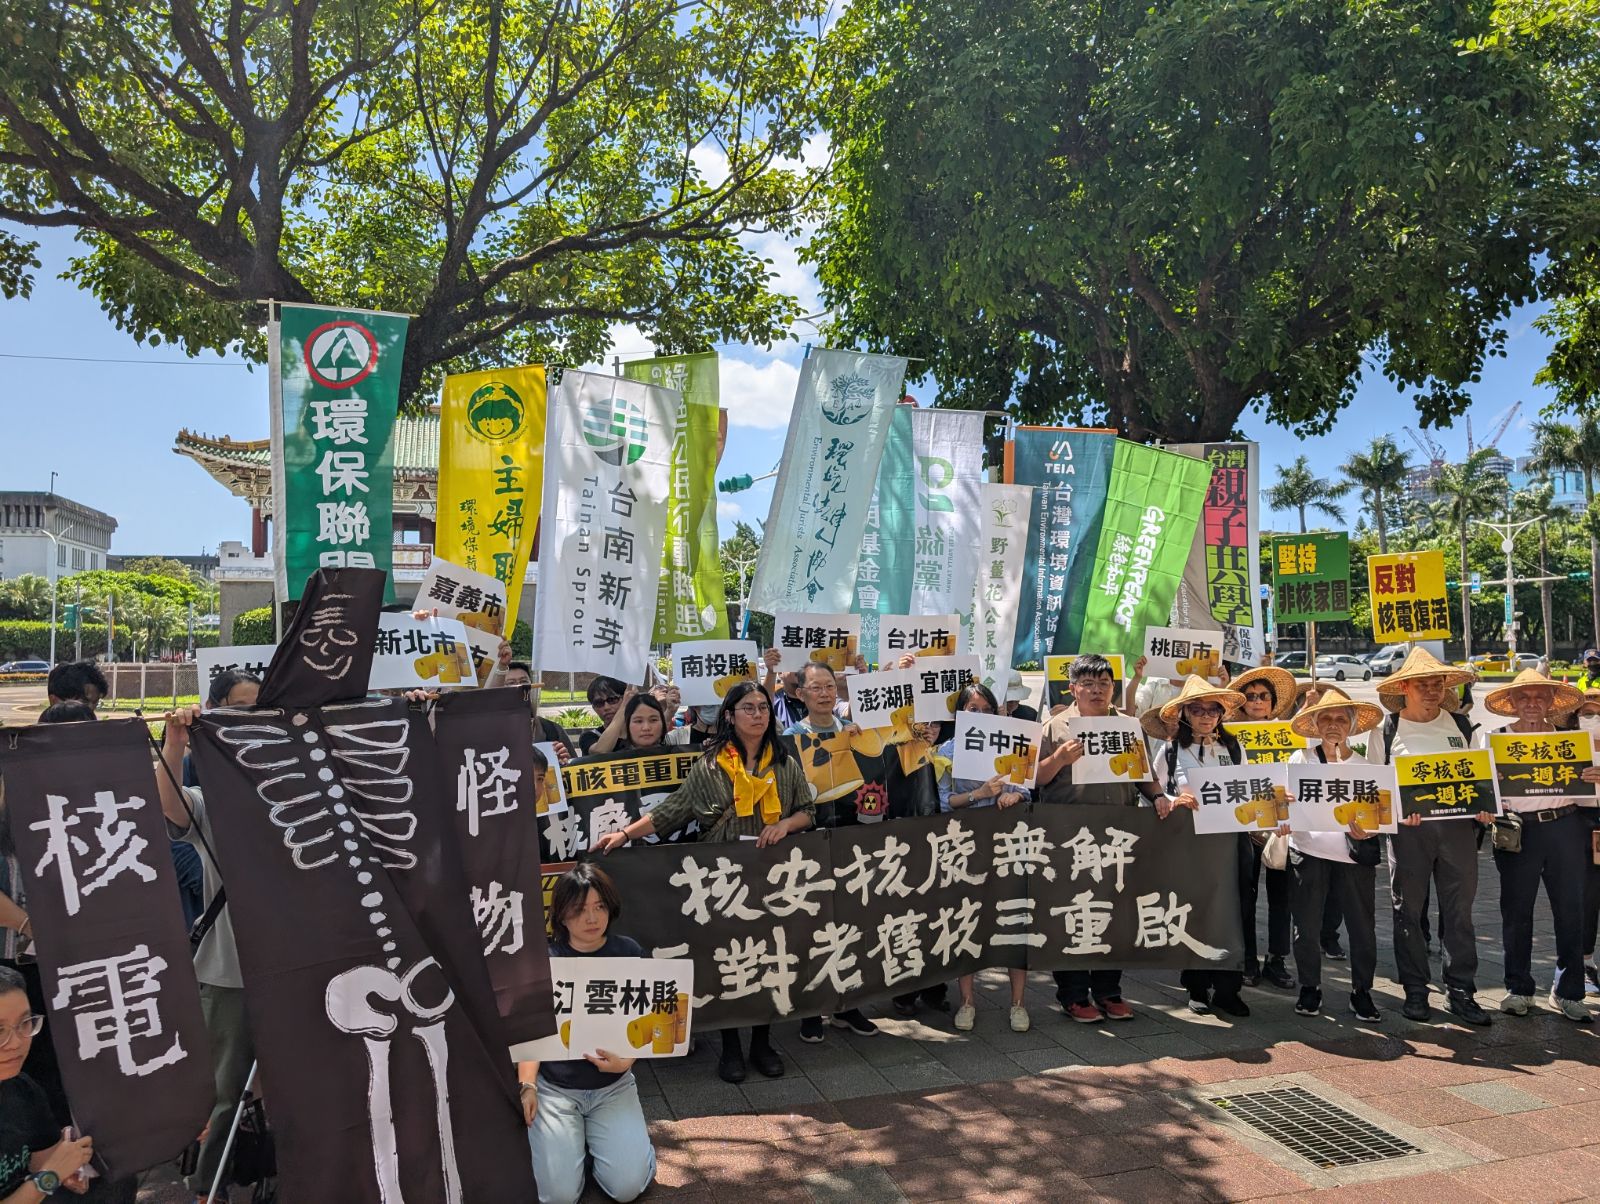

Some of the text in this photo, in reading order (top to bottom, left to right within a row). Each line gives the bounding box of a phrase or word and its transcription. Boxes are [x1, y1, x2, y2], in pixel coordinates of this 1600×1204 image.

[1045, 463, 1075, 475] TEIA
[572, 476, 599, 646] Tainan Sprout
[592, 480, 638, 655] 台南新芽
[1033, 481, 1051, 653] Taiwan Environmental Information Association
[1098, 532, 1132, 596] 綠色和平
[1279, 543, 1316, 574] 堅持
[1374, 563, 1416, 594] 反對
[428, 575, 501, 617] 嘉義市
[1279, 580, 1347, 614] 非核家園
[1378, 597, 1448, 634] 核電復活
[374, 628, 456, 655] 新北市
[781, 626, 849, 649] 基隆市
[888, 628, 949, 649] 台北市
[1151, 637, 1212, 659] 桃園市
[681, 653, 750, 678] 南投縣
[921, 668, 974, 693] 宜蘭縣
[964, 727, 1031, 757] 台中市
[1077, 731, 1140, 756] 花蓮縣
[1238, 728, 1292, 748] 零核電
[1507, 740, 1577, 762] 零核電
[1411, 758, 1476, 783] 零核電
[1508, 764, 1578, 786] 一週年
[1200, 777, 1276, 805] 台東縣
[1298, 778, 1380, 804] 屏東縣
[1415, 783, 1479, 806] 一週年
[457, 745, 524, 955] 怪物
[668, 819, 1141, 925] 核安核廢無解
[28, 791, 188, 1077] 核電
[652, 891, 1229, 1016] 對老舊核三重啟
[584, 980, 678, 1015] 雲林縣
